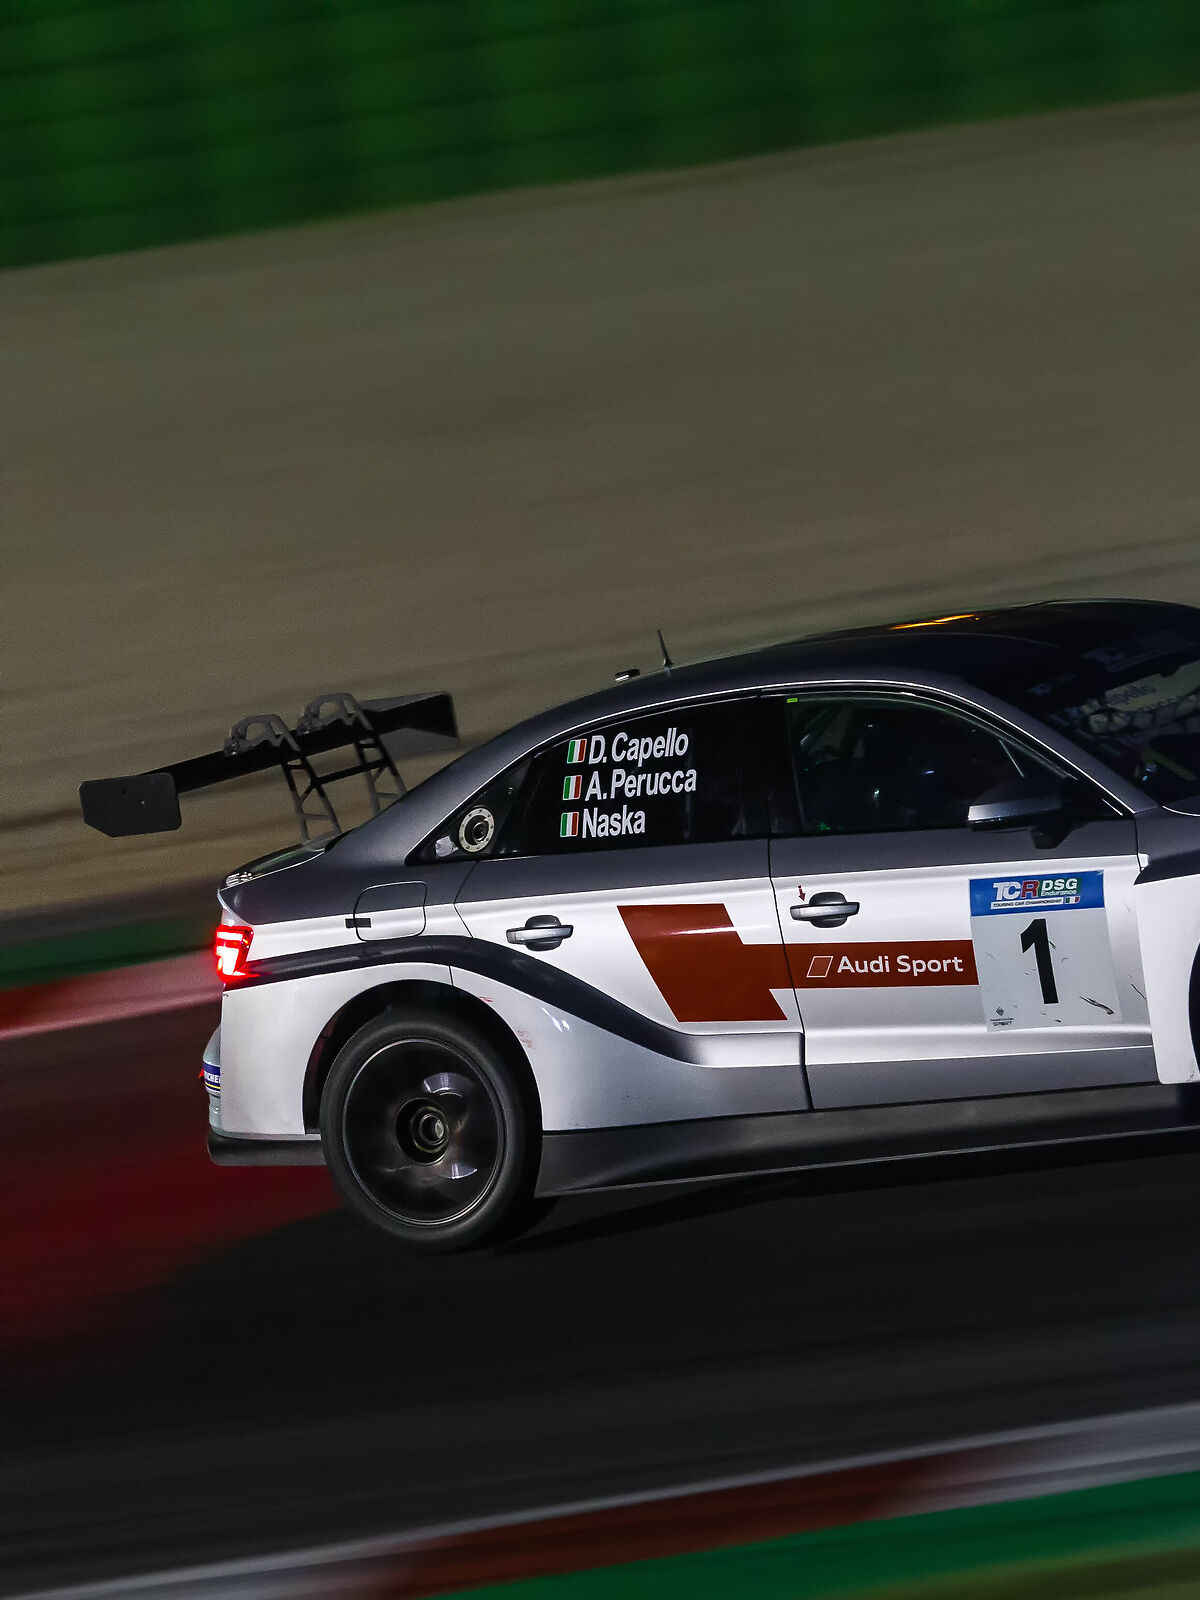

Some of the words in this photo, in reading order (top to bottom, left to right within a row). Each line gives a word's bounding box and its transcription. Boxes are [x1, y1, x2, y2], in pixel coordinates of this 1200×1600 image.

[588, 735, 607, 765] D.
[611, 727, 689, 768] Capello
[584, 770, 607, 802] A.
[610, 768, 697, 799] Perucca
[581, 804, 646, 839] Naska
[992, 880, 1040, 901] TCR
[1041, 878, 1078, 891] DSG
[837, 955, 890, 974] Audi
[896, 955, 964, 977] Sport
[1020, 918, 1059, 1005] 1
